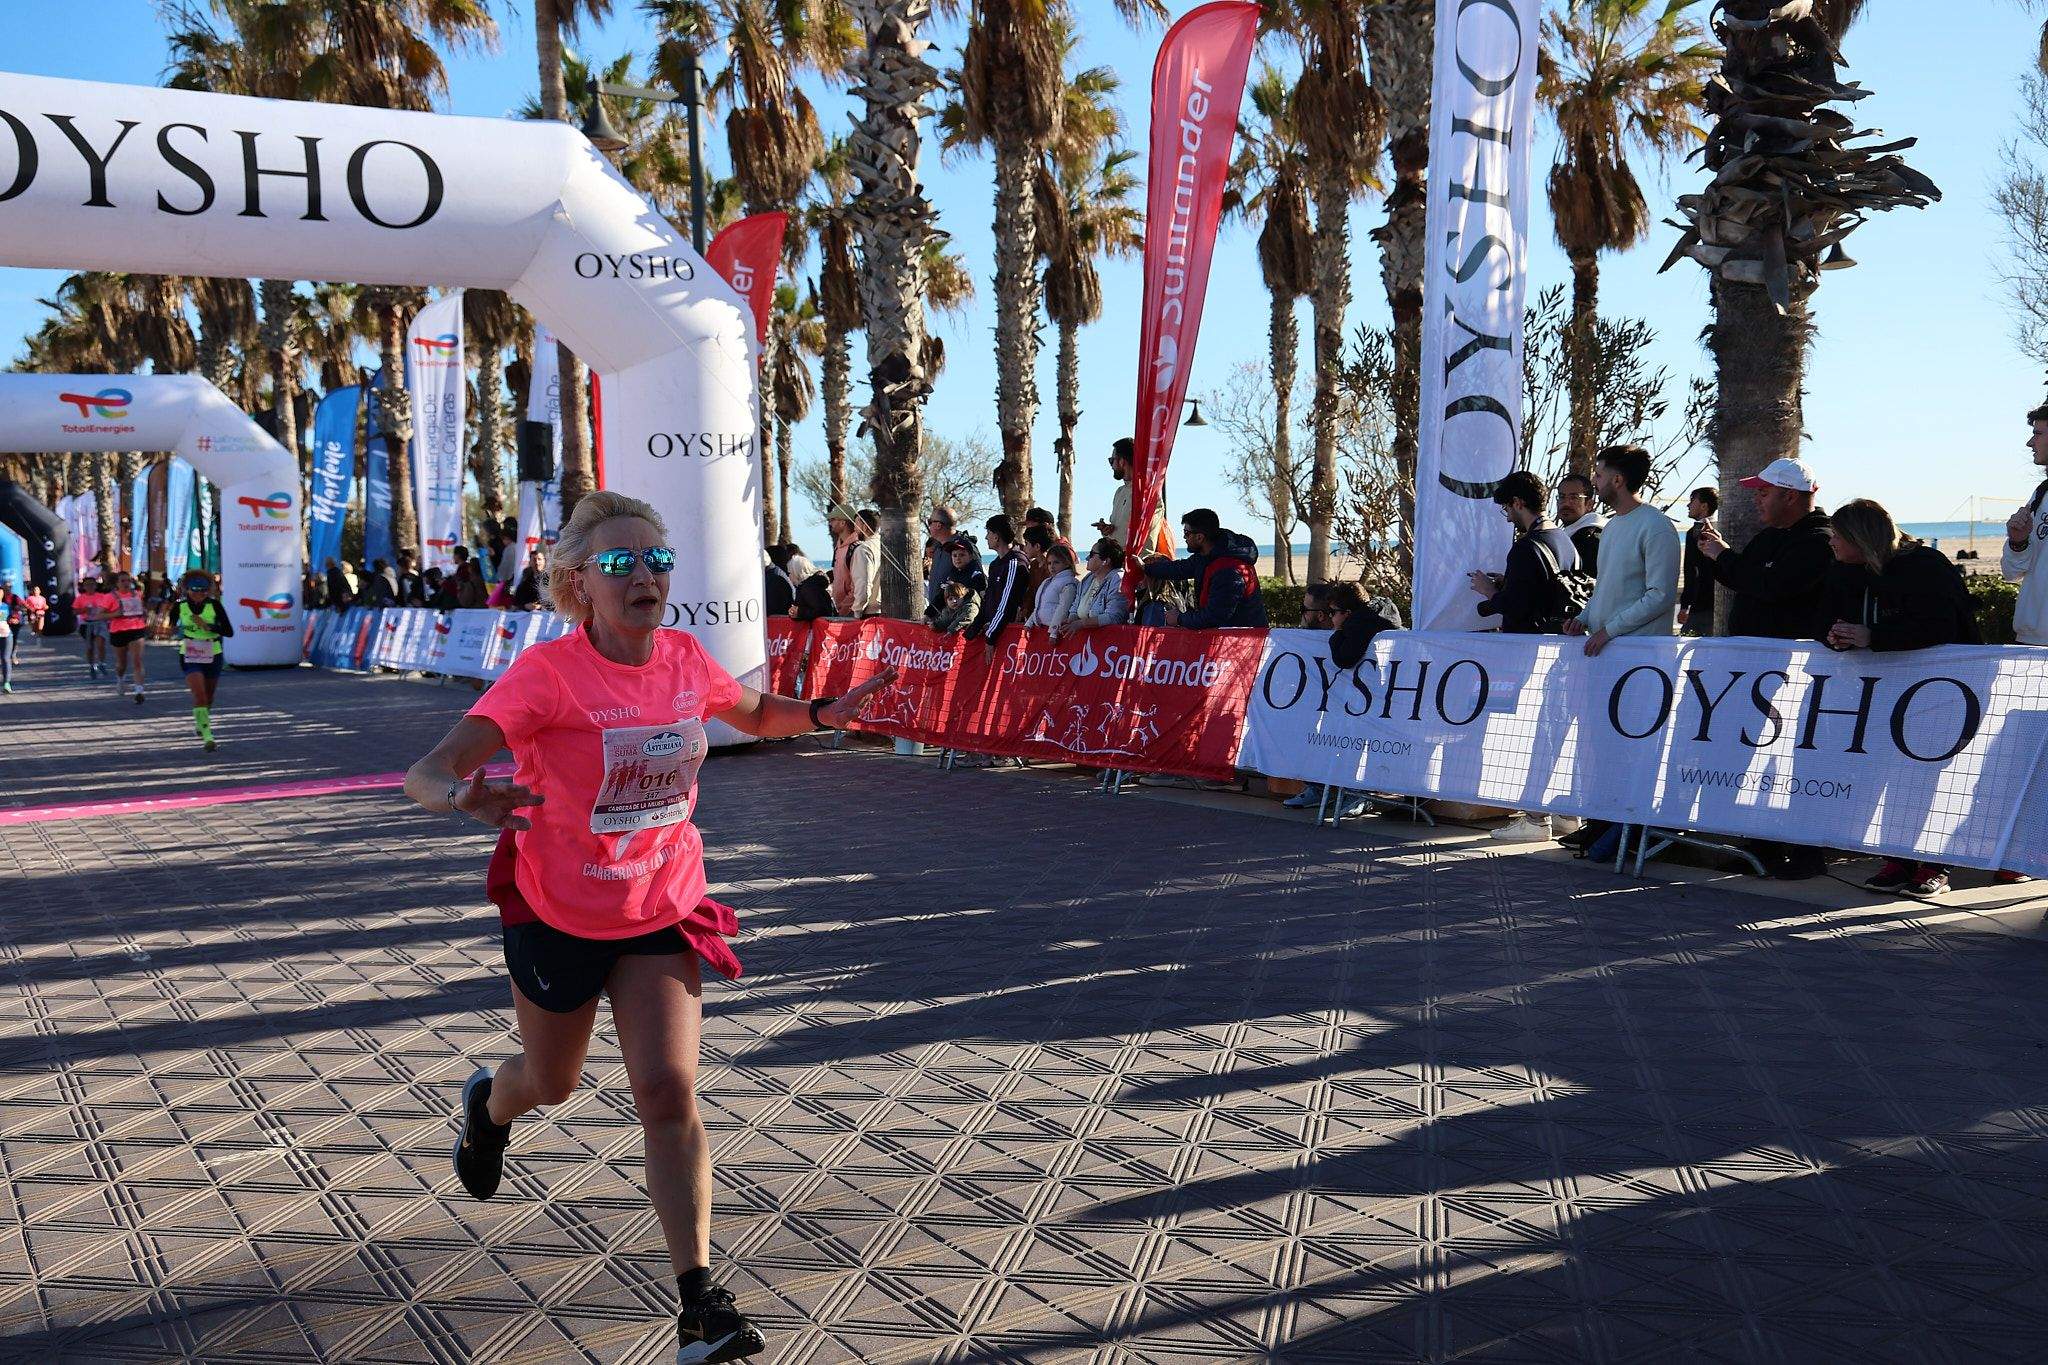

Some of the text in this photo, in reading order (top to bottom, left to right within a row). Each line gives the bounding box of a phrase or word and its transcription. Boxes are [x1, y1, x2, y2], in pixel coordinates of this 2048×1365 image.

[1438, 0, 1523, 499] OYSHO
[574, 252, 695, 282] OYSHO
[731, 259, 755, 292] er
[61, 424, 136, 434] TotalEnergies
[648, 432, 755, 459] OYSHO
[881, 638, 959, 672] Santander
[1003, 643, 1230, 687] Sports Santander
[1262, 651, 1490, 726] OYSHO
[589, 705, 641, 723] OYSHO
[1608, 663, 1982, 763] OYSHO
[1307, 732, 1413, 756] WWW.OYSHO.COM
[1681, 767, 1853, 801] WWW.OYSHO.COM
[603, 816, 641, 826] OYSHO
[582, 862, 633, 881] CARRERA
